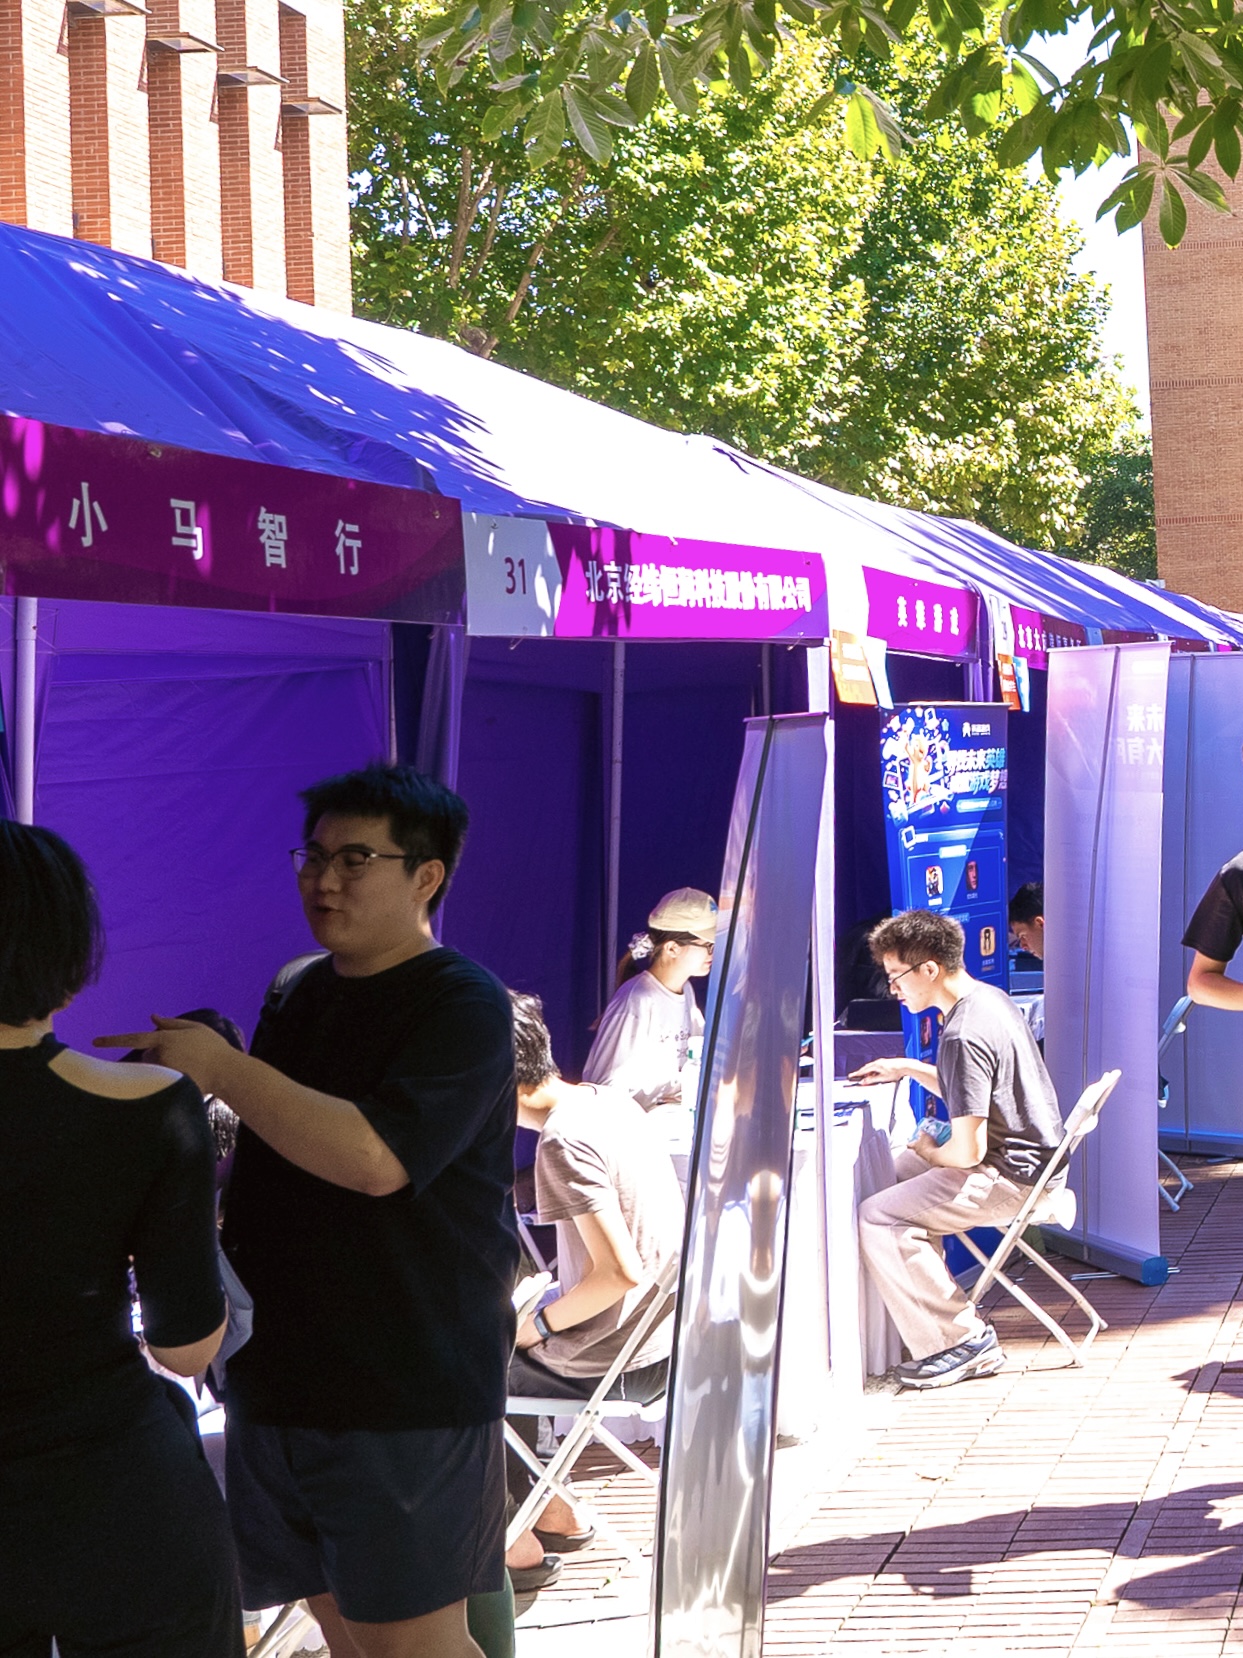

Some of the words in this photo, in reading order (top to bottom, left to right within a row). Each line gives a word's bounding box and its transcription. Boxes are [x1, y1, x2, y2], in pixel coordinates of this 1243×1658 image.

[68, 482, 362, 575] 小马智行
[504, 557, 527, 595] 31
